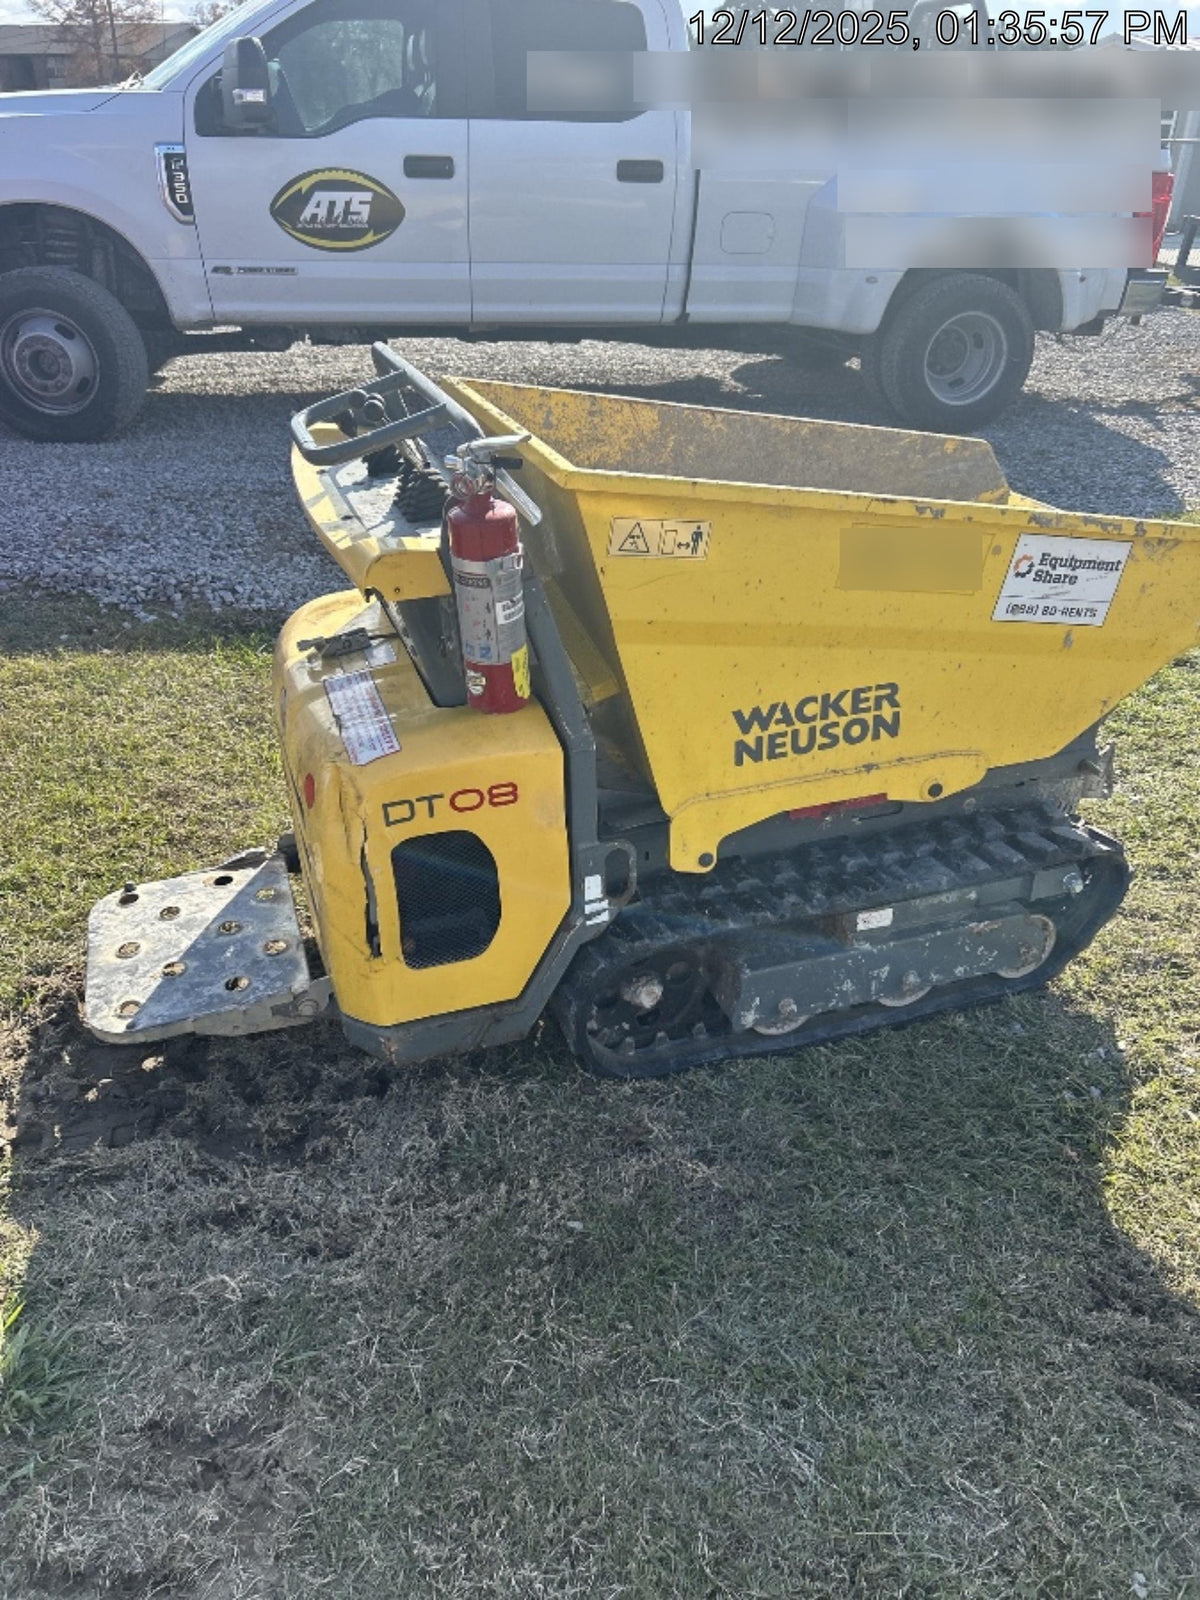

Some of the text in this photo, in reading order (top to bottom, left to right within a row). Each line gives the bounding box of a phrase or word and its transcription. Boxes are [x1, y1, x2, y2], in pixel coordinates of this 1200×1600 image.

[299, 191, 374, 224] ATS
[1032, 568, 1078, 586] Share
[1039, 552, 1122, 572] Equipment
[732, 682, 901, 735] WACKER
[734, 711, 901, 766] NEUSON
[382, 782, 518, 827] DT08
